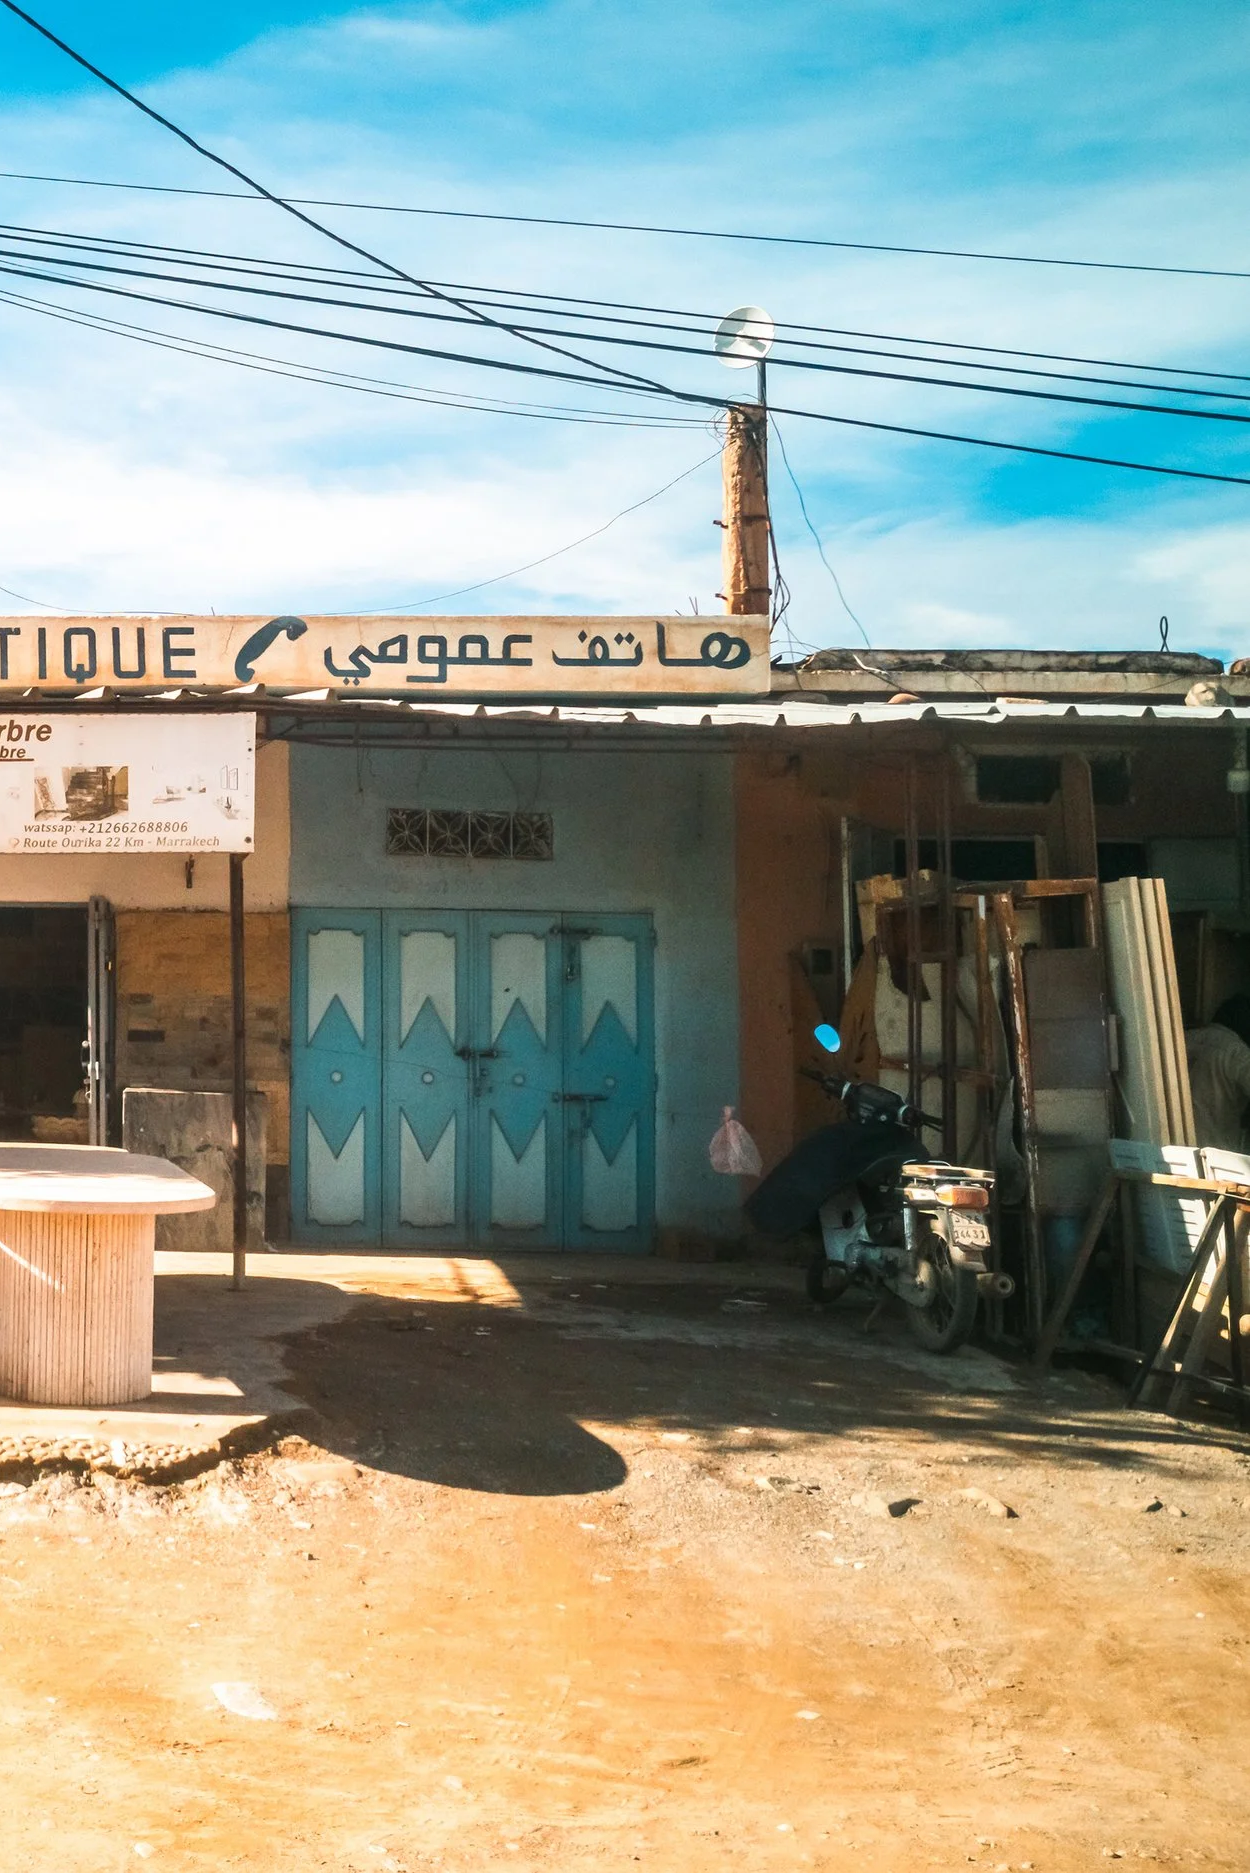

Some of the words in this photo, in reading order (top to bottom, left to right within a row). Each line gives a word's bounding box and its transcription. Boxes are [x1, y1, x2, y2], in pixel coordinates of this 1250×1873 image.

[323, 633, 533, 686] عمومي
[551, 620, 751, 670] هاتف
[23, 823, 76, 835] watssap:
[79, 821, 189, 834] +212662688806
[23, 837, 58, 848] Route
[61, 837, 102, 848] Ourika
[105, 837, 121, 848] 22
[124, 837, 144, 847] Km
[156, 835, 220, 847] Marrakech
